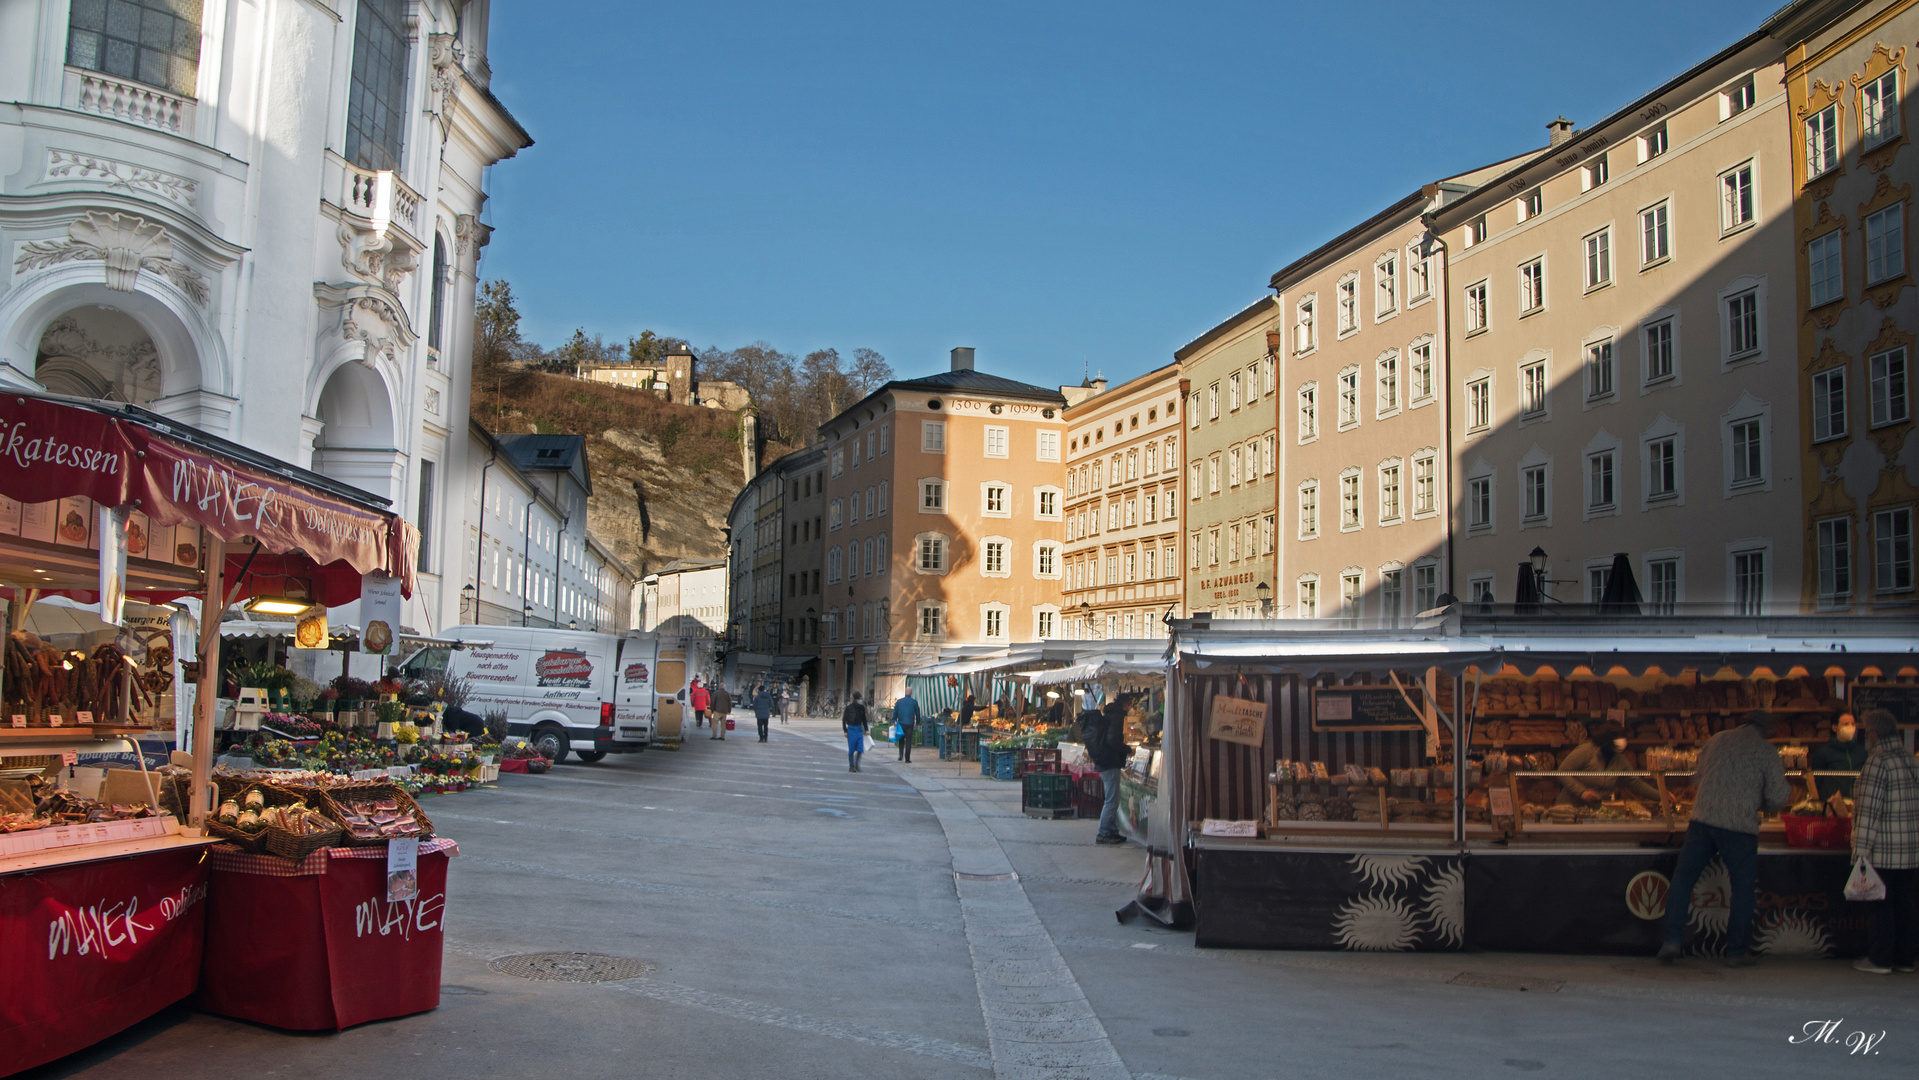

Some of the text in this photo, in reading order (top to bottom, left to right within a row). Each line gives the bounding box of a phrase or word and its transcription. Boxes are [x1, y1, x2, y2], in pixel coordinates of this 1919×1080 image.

[1640, 102, 1668, 121] 2003
[1009, 403, 1038, 416] 1999
[173, 458, 373, 546] MAYER Delikatessen
[1213, 571, 1254, 588] AZWANGER
[123, 615, 156, 626] burger
[469, 650, 520, 661] Hausgemachtes
[562, 677, 589, 685] Leitner
[543, 690, 581, 699] Anthering
[356, 889, 445, 941] MAYE
[48, 895, 155, 960] MAYER
